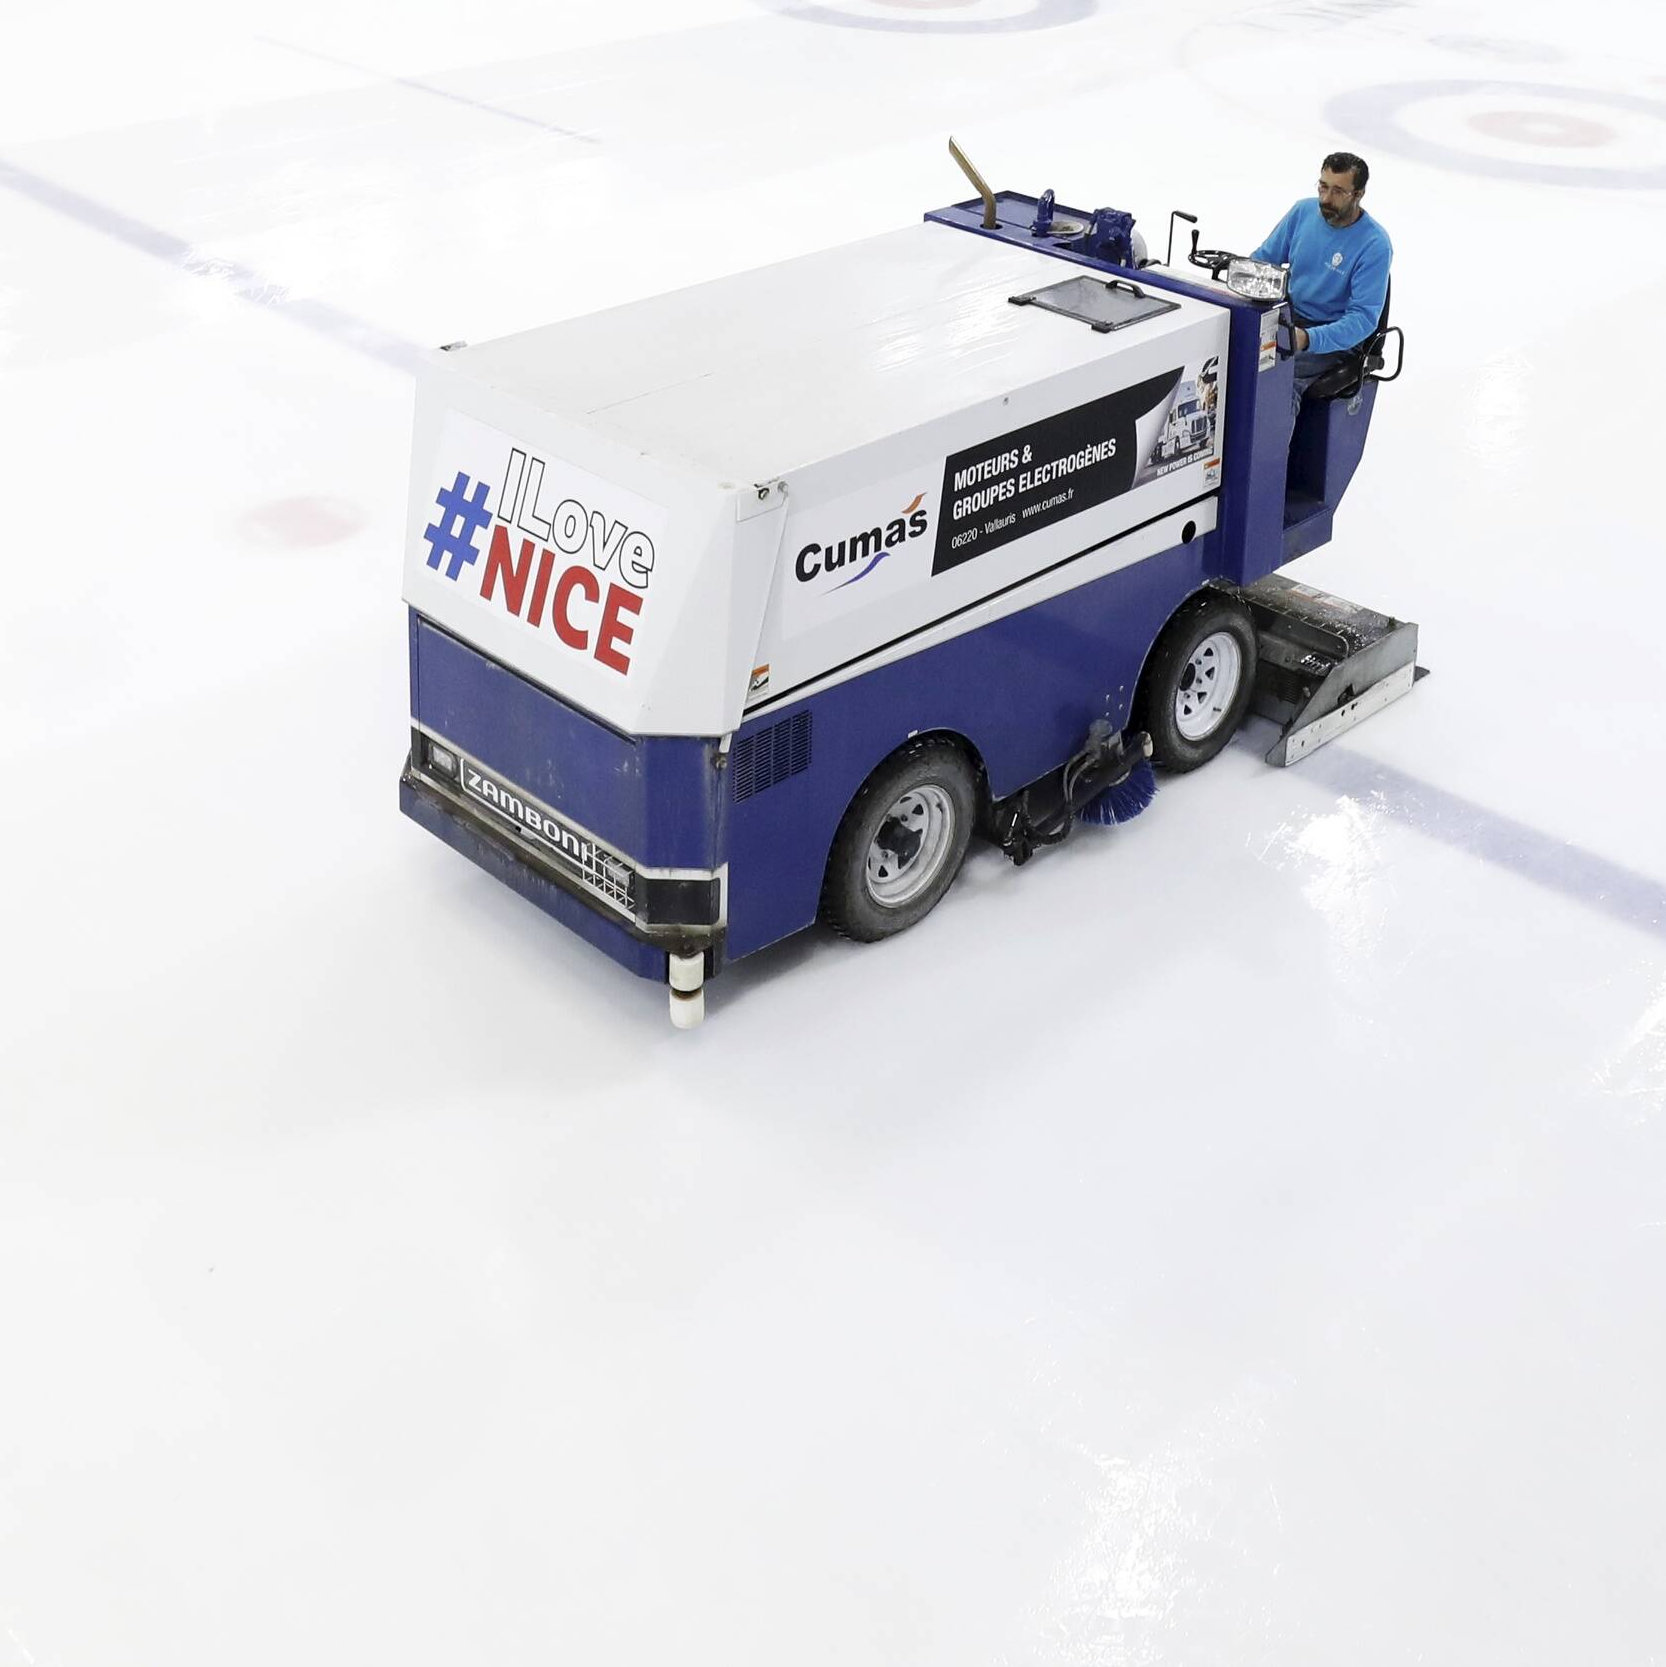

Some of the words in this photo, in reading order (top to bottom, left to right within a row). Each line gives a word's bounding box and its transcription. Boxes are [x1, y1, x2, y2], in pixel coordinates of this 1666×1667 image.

[952, 484, 1015, 521] GROUPES
[1018, 438, 1117, 494] ELECTROGÈNES
[954, 452, 1019, 492] MOTEURS
[1021, 444, 1033, 462] &
[1156, 465, 1169, 477] NEW
[1169, 459, 1187, 471] POWER
[1188, 454, 1193, 464] IS
[795, 508, 929, 583] Cumas
[951, 528, 979, 550] 06220
[984, 511, 1016, 533] Vallauris
[1022, 487, 1075, 519] www.cumas.fr
[479, 524, 644, 676] NICE
[467, 768, 589, 862] ZAMBONI
